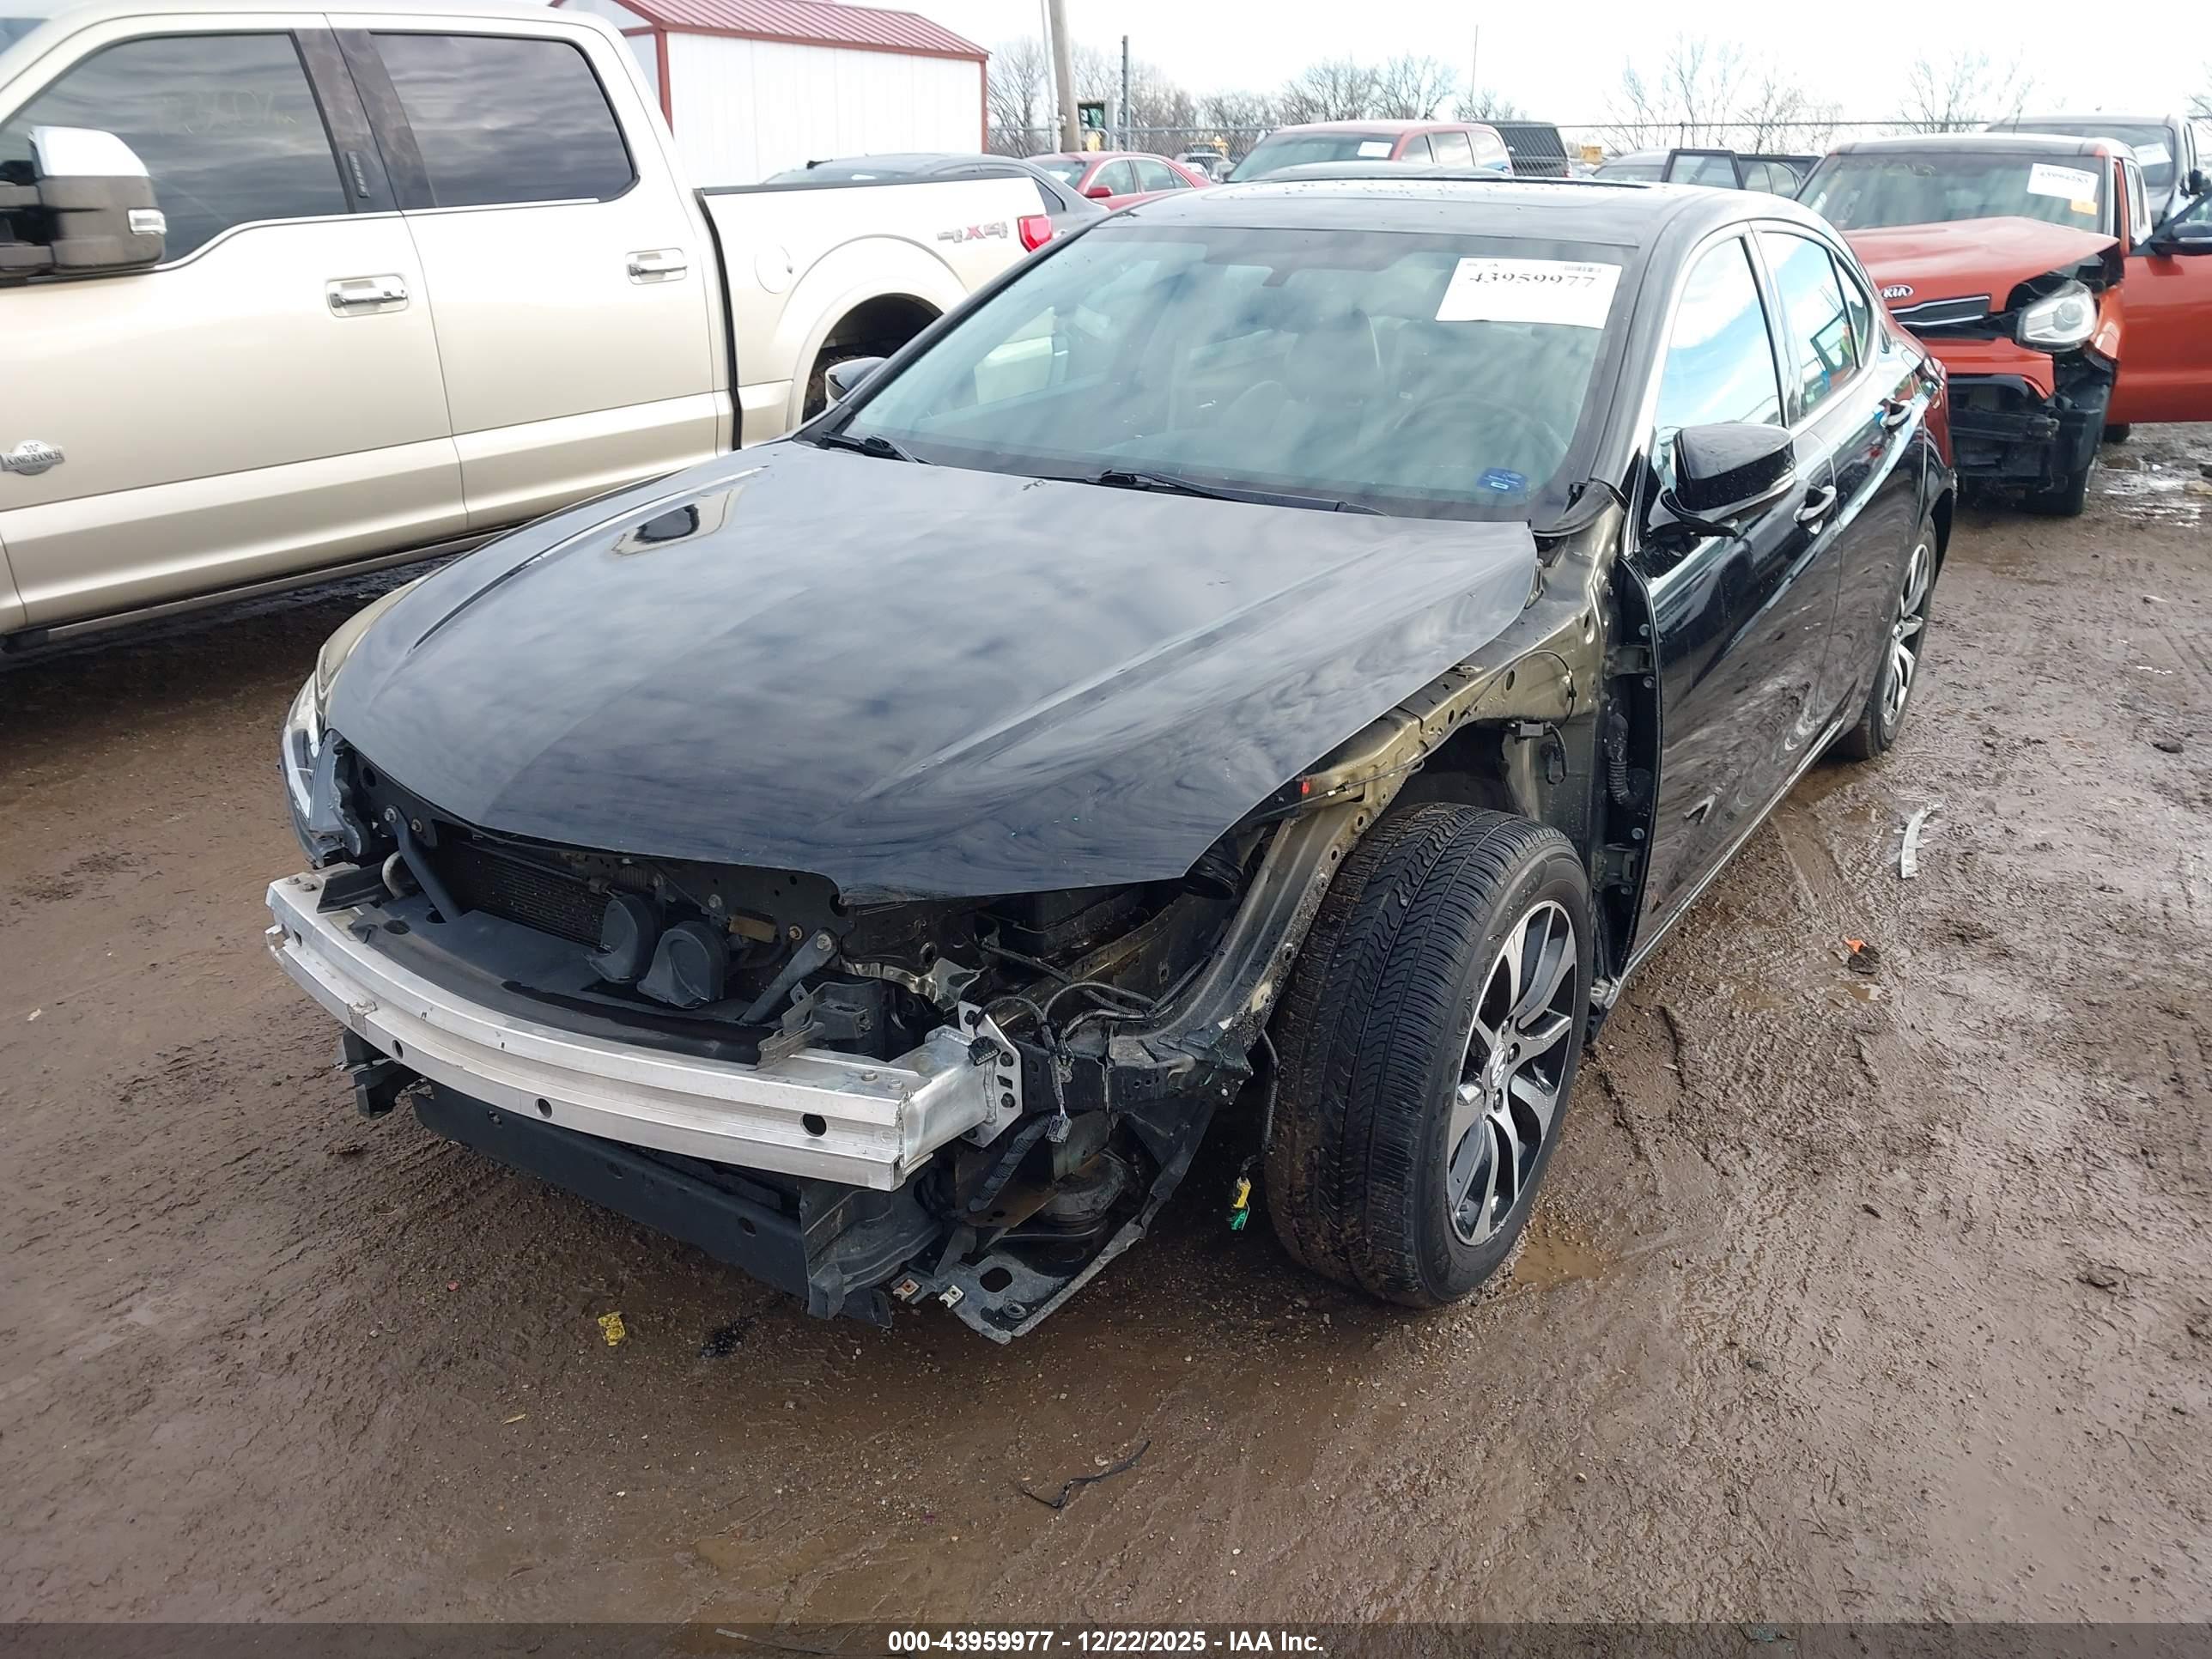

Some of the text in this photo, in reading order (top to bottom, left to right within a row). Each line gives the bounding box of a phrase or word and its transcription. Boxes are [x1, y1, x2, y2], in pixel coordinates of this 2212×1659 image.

[937, 221, 1009, 243] 4X4
[1469, 271, 1596, 288] 43959977
[1883, 287, 1908, 298] KIA
